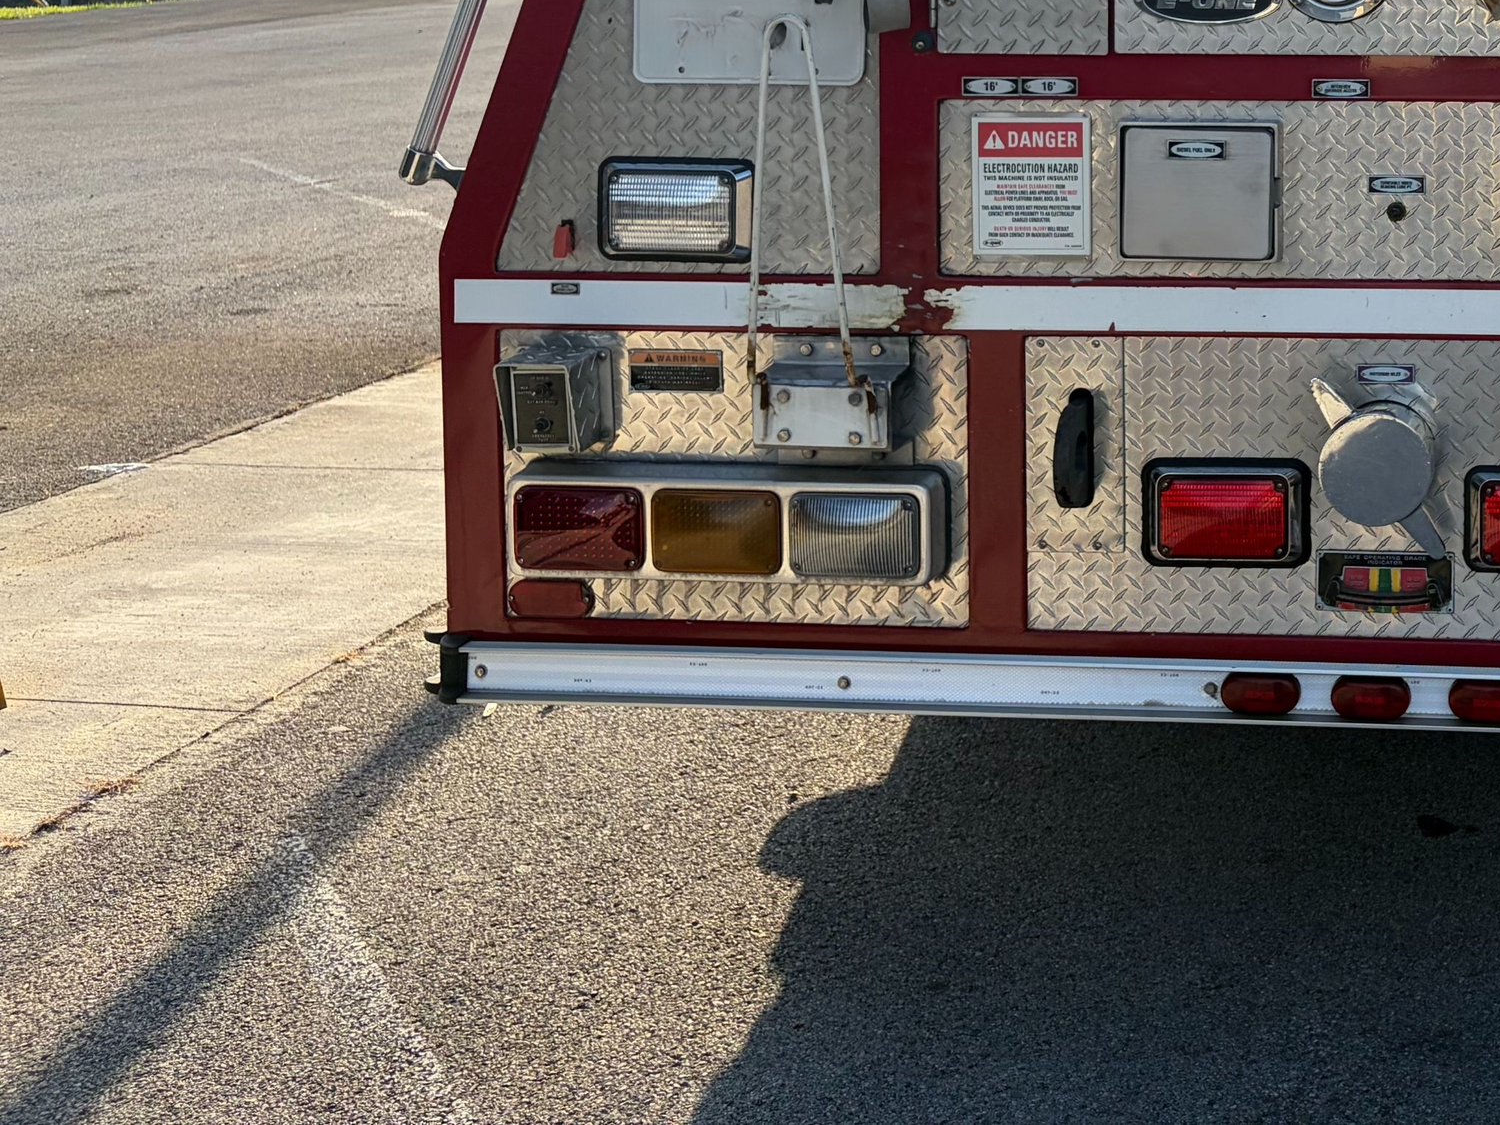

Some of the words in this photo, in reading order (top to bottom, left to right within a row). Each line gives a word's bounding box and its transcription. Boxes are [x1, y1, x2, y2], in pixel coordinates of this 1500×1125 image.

[983, 81, 998, 91] 16'
[1041, 81, 1056, 91] 16'
[1007, 131, 1078, 148] DANGER
[983, 163, 1045, 174] ELECTROCUTION
[1047, 163, 1079, 174] HAZARD
